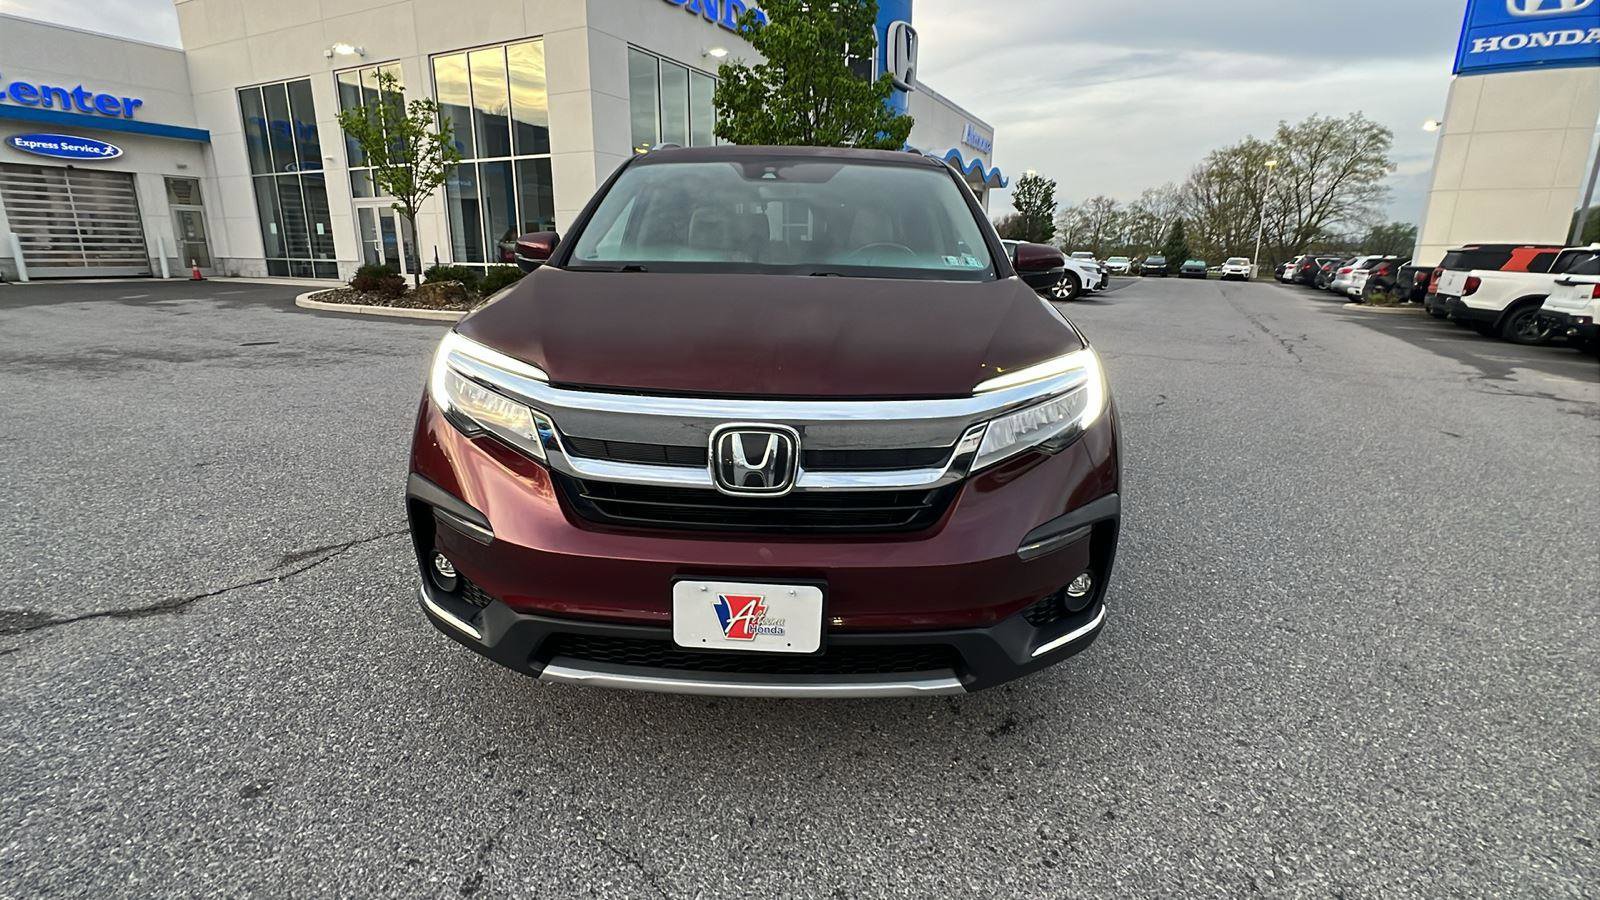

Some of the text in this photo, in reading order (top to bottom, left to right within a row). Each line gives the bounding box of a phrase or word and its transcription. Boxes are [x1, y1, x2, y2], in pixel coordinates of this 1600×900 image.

[1470, 28, 1600, 54] HONDA
[0, 73, 143, 118] enter
[14, 138, 101, 153] Express Service
[749, 624, 784, 635] Honda
